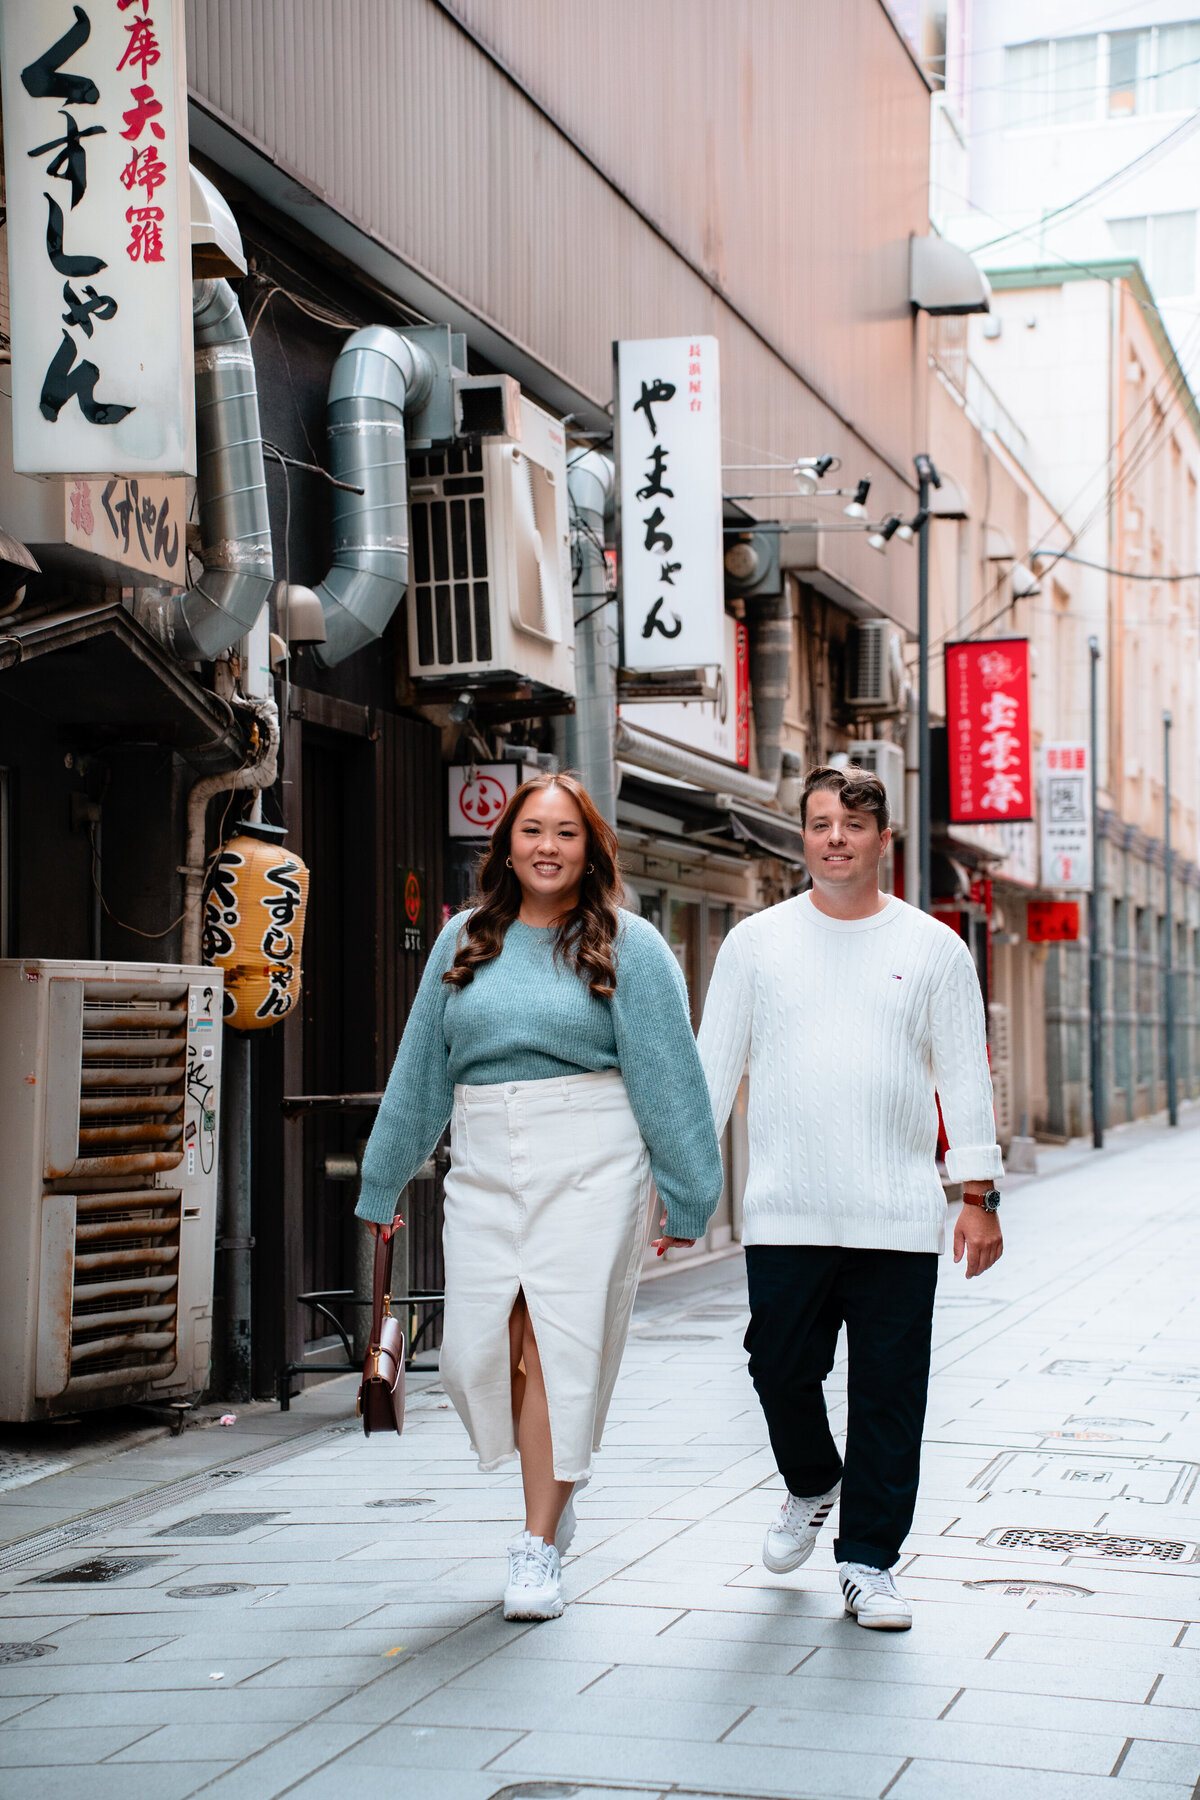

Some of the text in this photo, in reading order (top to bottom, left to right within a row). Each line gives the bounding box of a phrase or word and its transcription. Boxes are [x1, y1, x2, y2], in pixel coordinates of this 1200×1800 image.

[21, 5, 137, 426] くすしゃん
[688, 344, 702, 412] 長浜屋台
[101, 480, 179, 568] くすしゃん
[633, 379, 682, 639] やまちゃん
